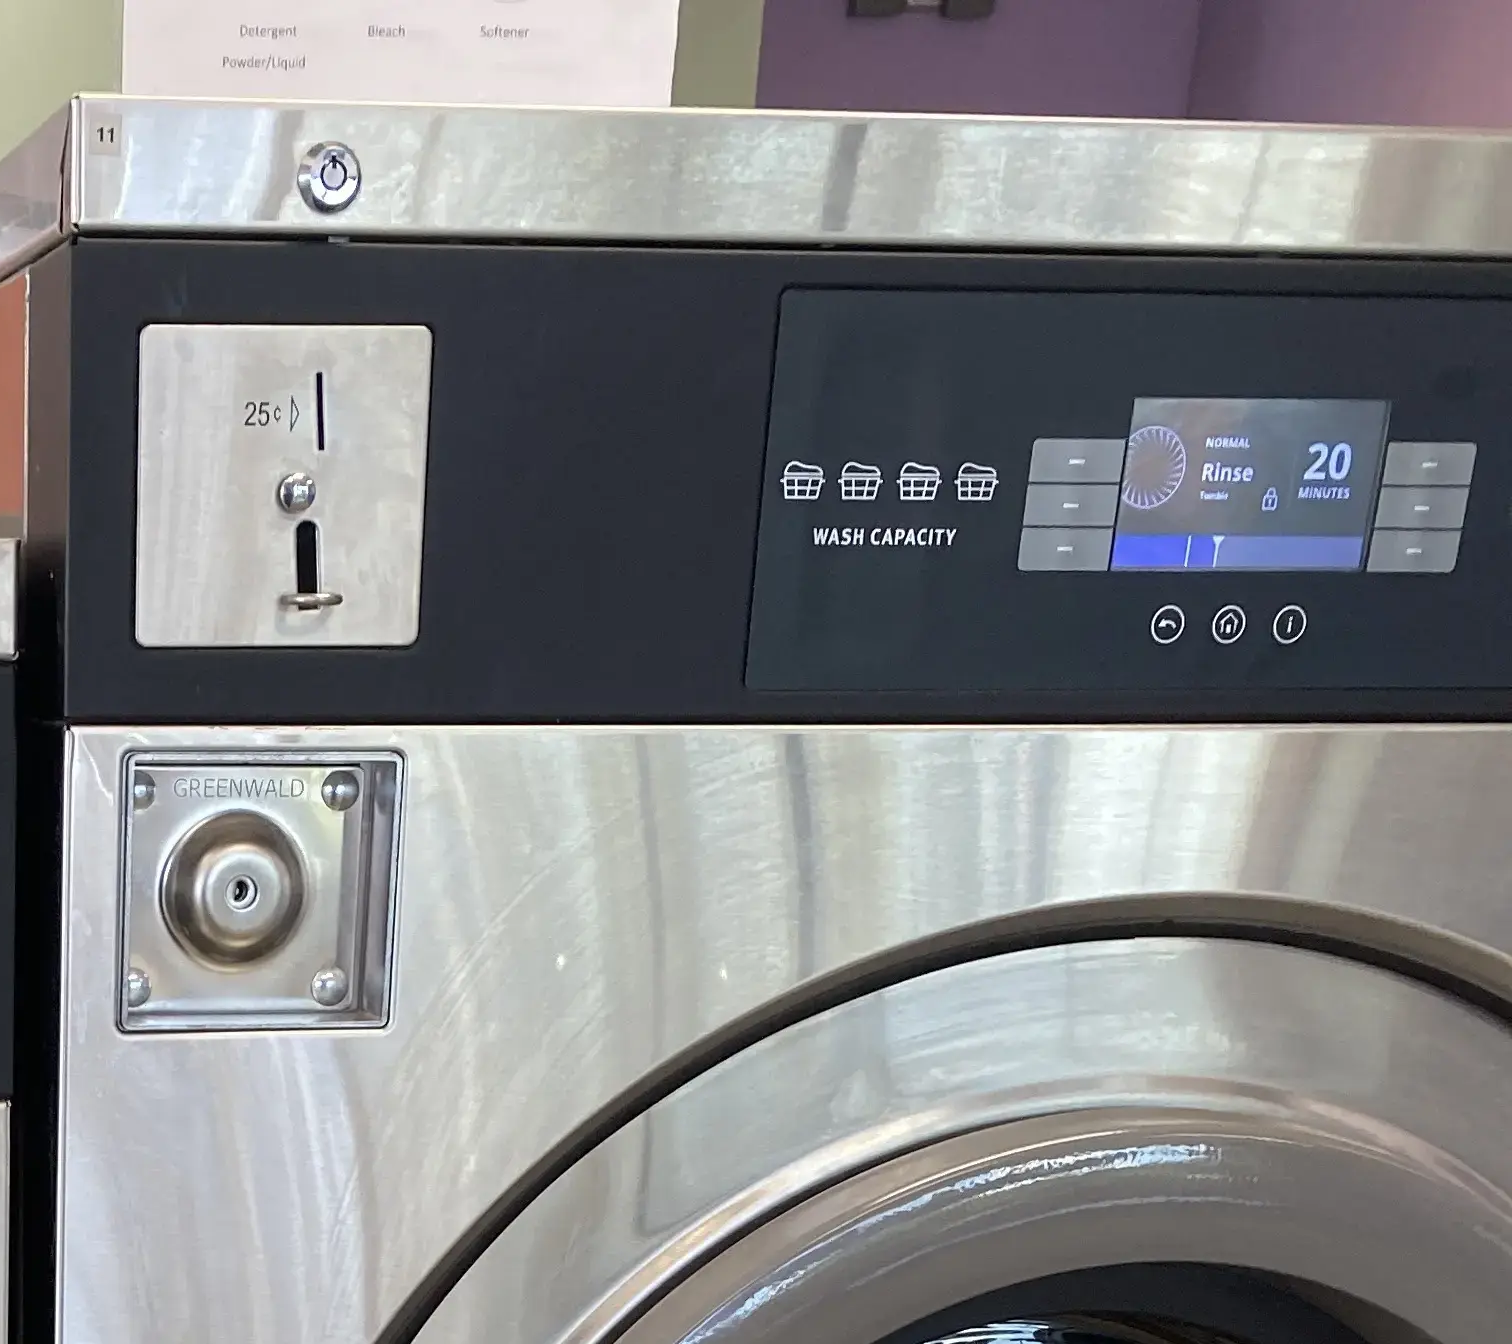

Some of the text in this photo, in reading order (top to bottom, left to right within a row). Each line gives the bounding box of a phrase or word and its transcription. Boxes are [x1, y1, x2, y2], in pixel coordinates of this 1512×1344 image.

[239, 24, 297, 40] Detergent
[367, 24, 406, 38] Bleach
[479, 25, 529, 39] Softener
[222, 55, 306, 71] Powder/Liquid
[96, 126, 115, 143] 11
[1205, 436, 1251, 449] NORMAL
[1303, 442, 1353, 481] 20
[1201, 462, 1254, 482] Rinse
[1297, 486, 1351, 500] MINUTES
[813, 527, 957, 546] WASH CAPACITY
[173, 778, 305, 798] GREENWALD
